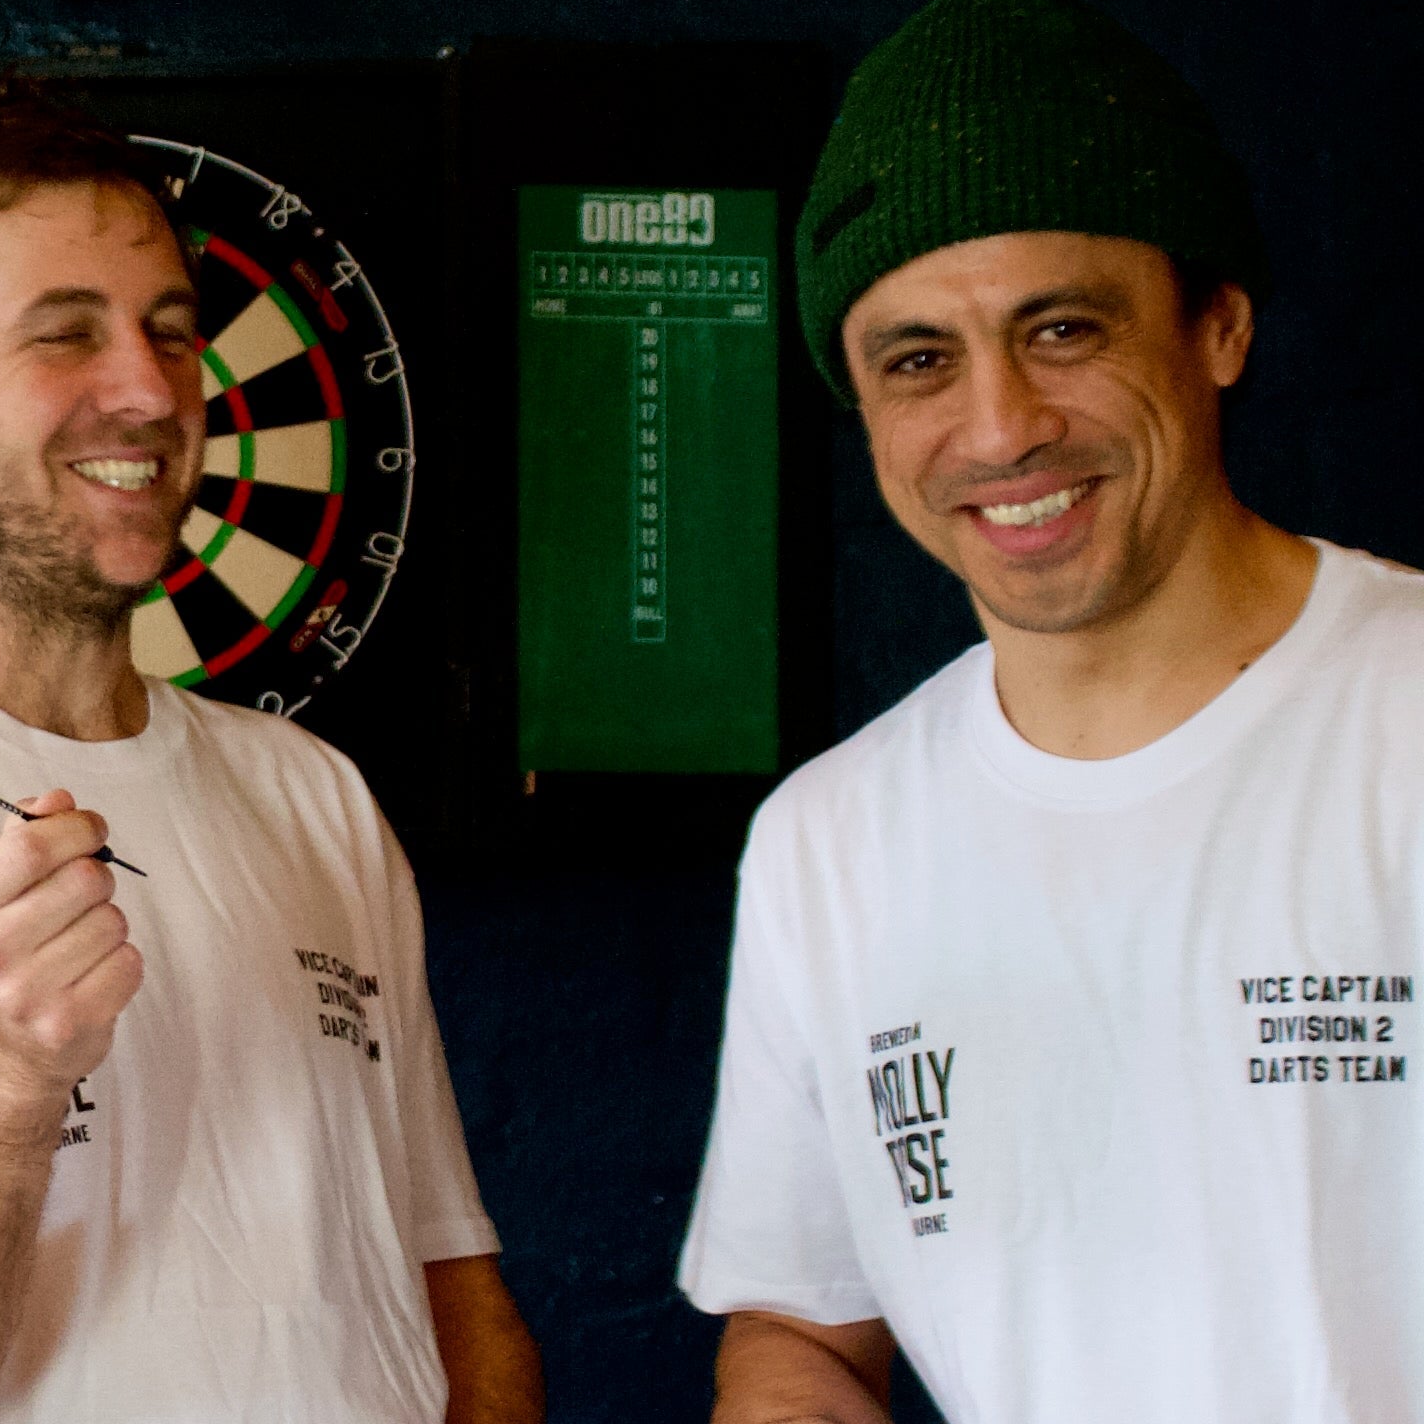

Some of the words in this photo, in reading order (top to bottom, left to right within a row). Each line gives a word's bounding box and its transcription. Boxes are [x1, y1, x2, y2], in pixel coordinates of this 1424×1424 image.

[259, 183, 303, 230] 18
[330, 259, 361, 291] 4
[376, 445, 415, 474] 6
[360, 531, 405, 575] 10
[317, 611, 363, 670] 15
[332, 957, 380, 997] CAPIN
[1240, 975, 1293, 1004] VICE
[1302, 974, 1414, 1003] CAPTAIN
[1259, 1015, 1367, 1044] DIVISION
[1374, 1015, 1395, 1043] 2
[1248, 1056, 1330, 1084] DARTS
[1338, 1055, 1408, 1083] TEAM
[886, 1128, 954, 1208] SE
